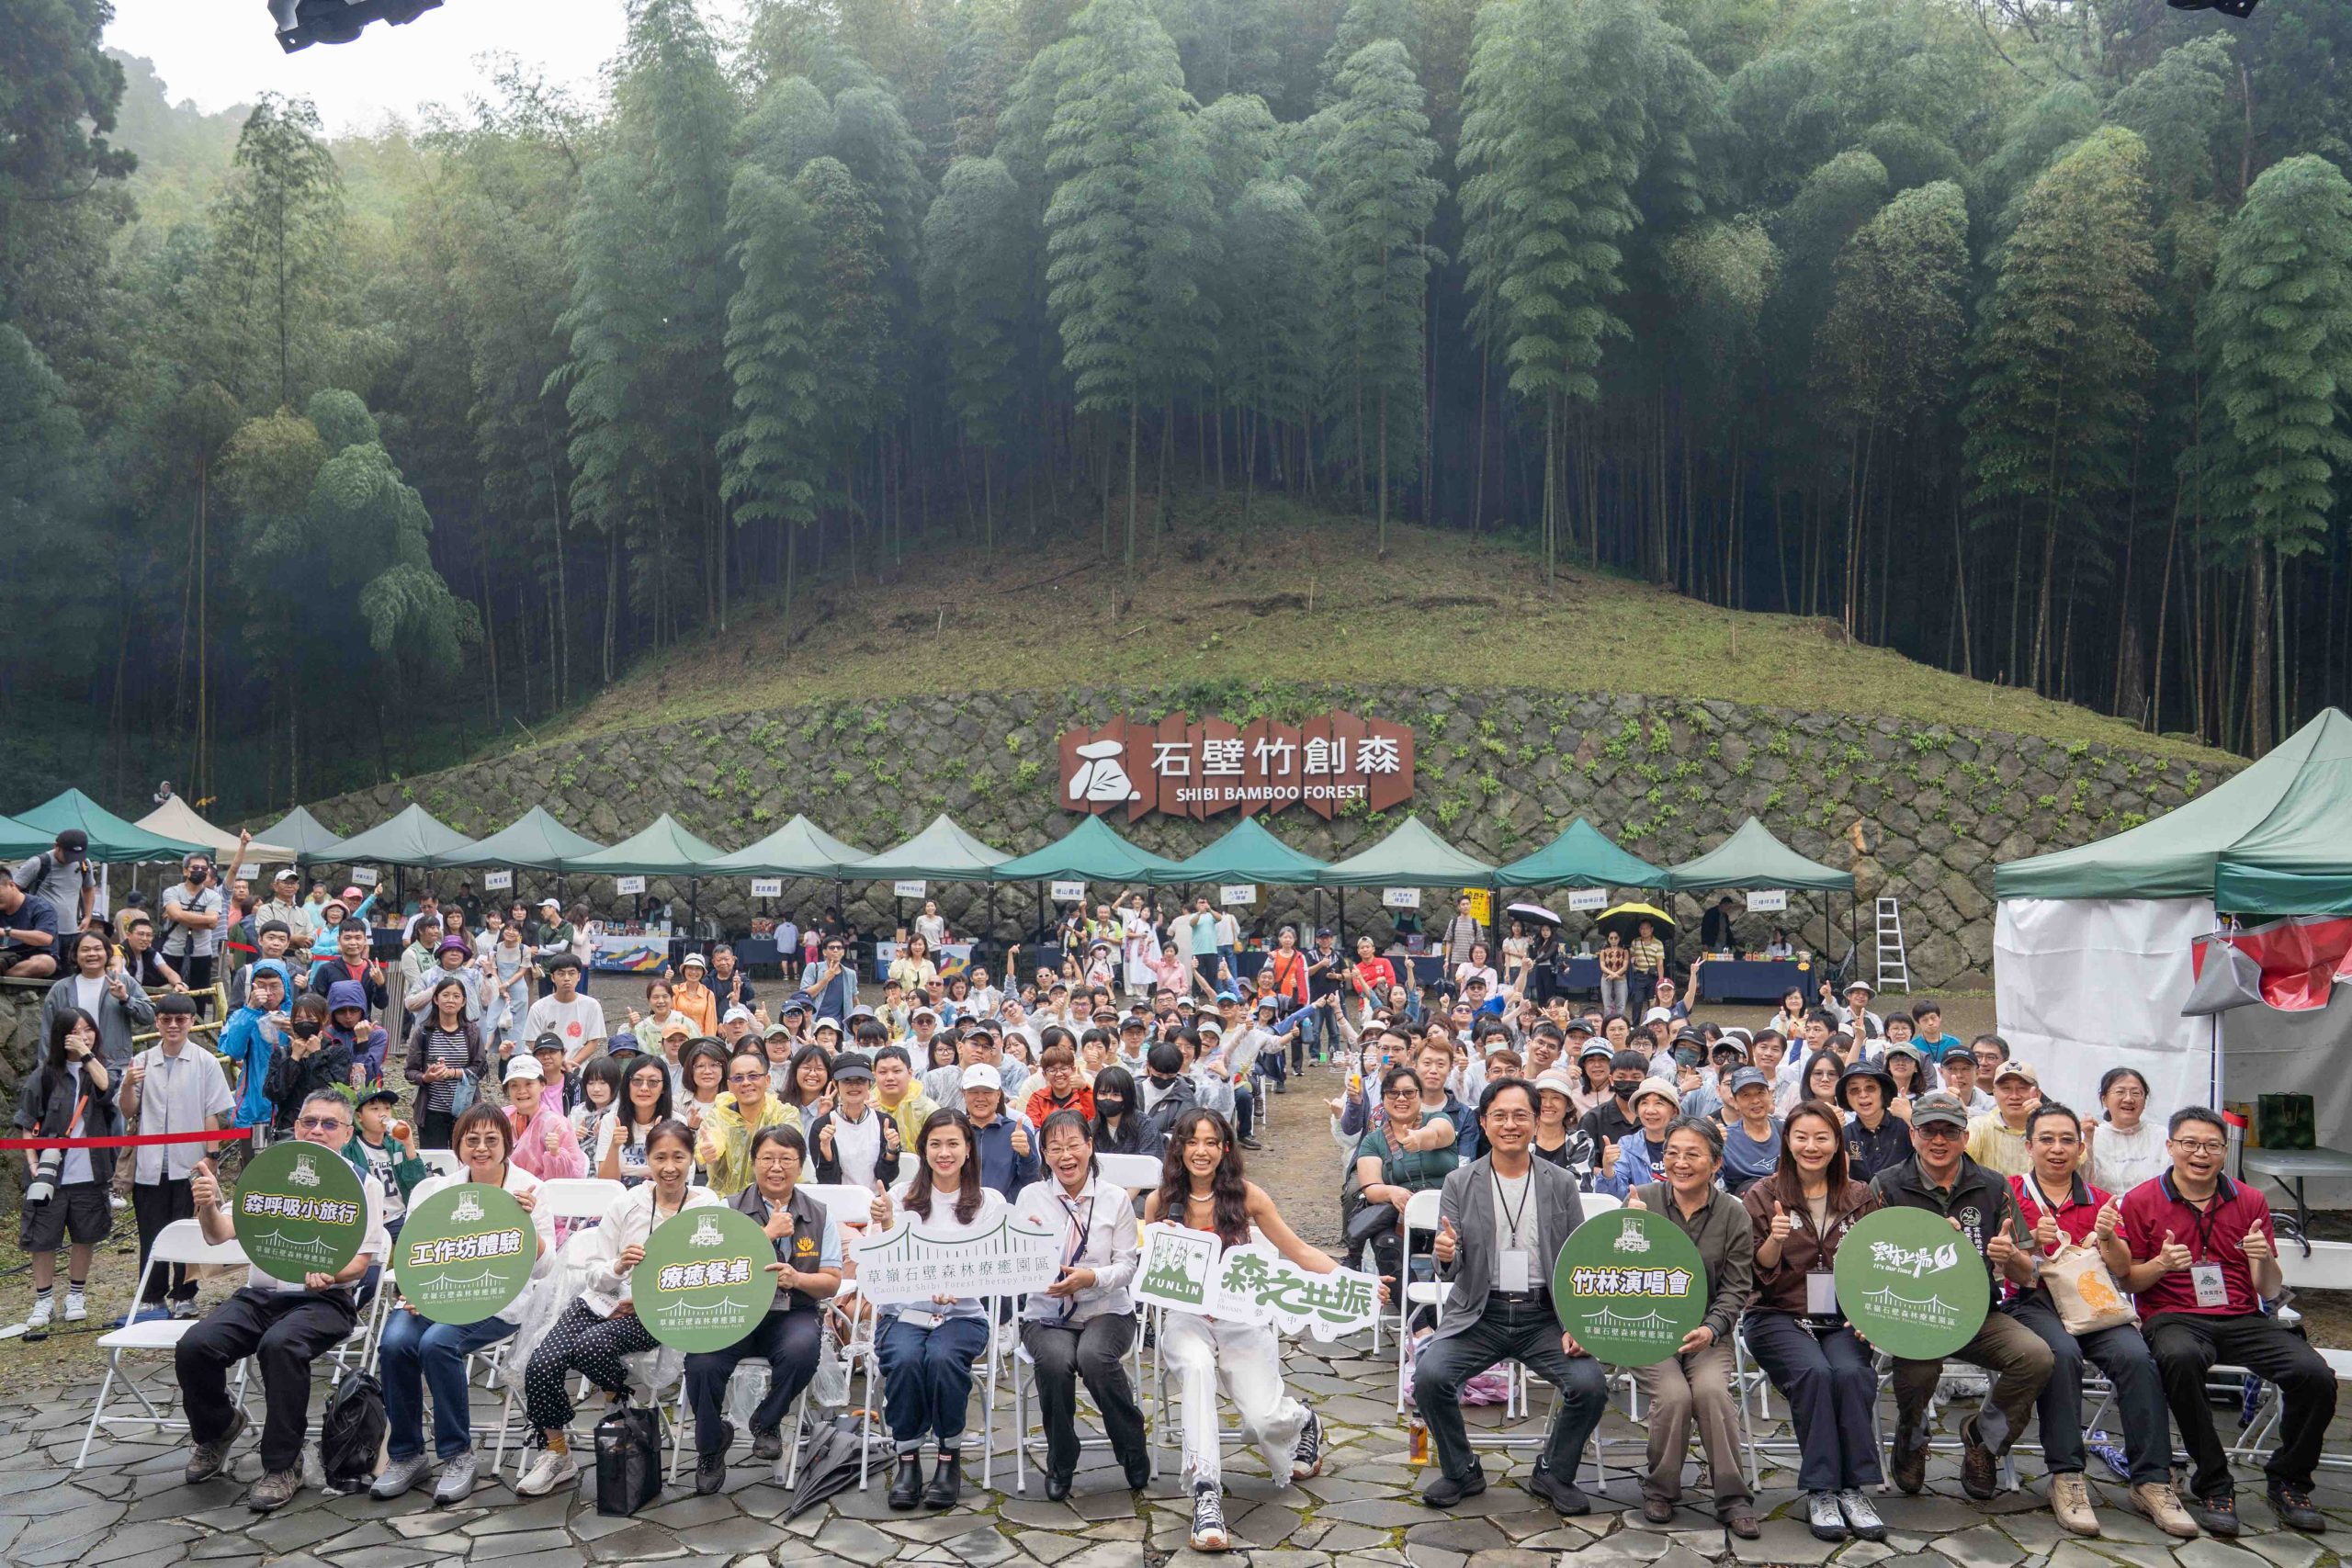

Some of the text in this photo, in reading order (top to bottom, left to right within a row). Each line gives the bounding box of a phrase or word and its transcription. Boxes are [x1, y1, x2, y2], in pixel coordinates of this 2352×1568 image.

[1151, 735, 1400, 776] 石壁竹創森
[1176, 784, 1366, 802] SHIBI BAMBOO FOREST
[244, 1193, 358, 1224] 森呼吸小旅行
[411, 1230, 522, 1265] 工作坊體驗
[1869, 1241, 1934, 1279] 雲林上場
[660, 1258, 751, 1290] 療癒餐桌
[867, 1257, 1049, 1284] 草嶺石壁森林療癒園區
[1148, 1276, 1200, 1296] YUNLIN
[1573, 1269, 1691, 1295] 竹林演唱會
